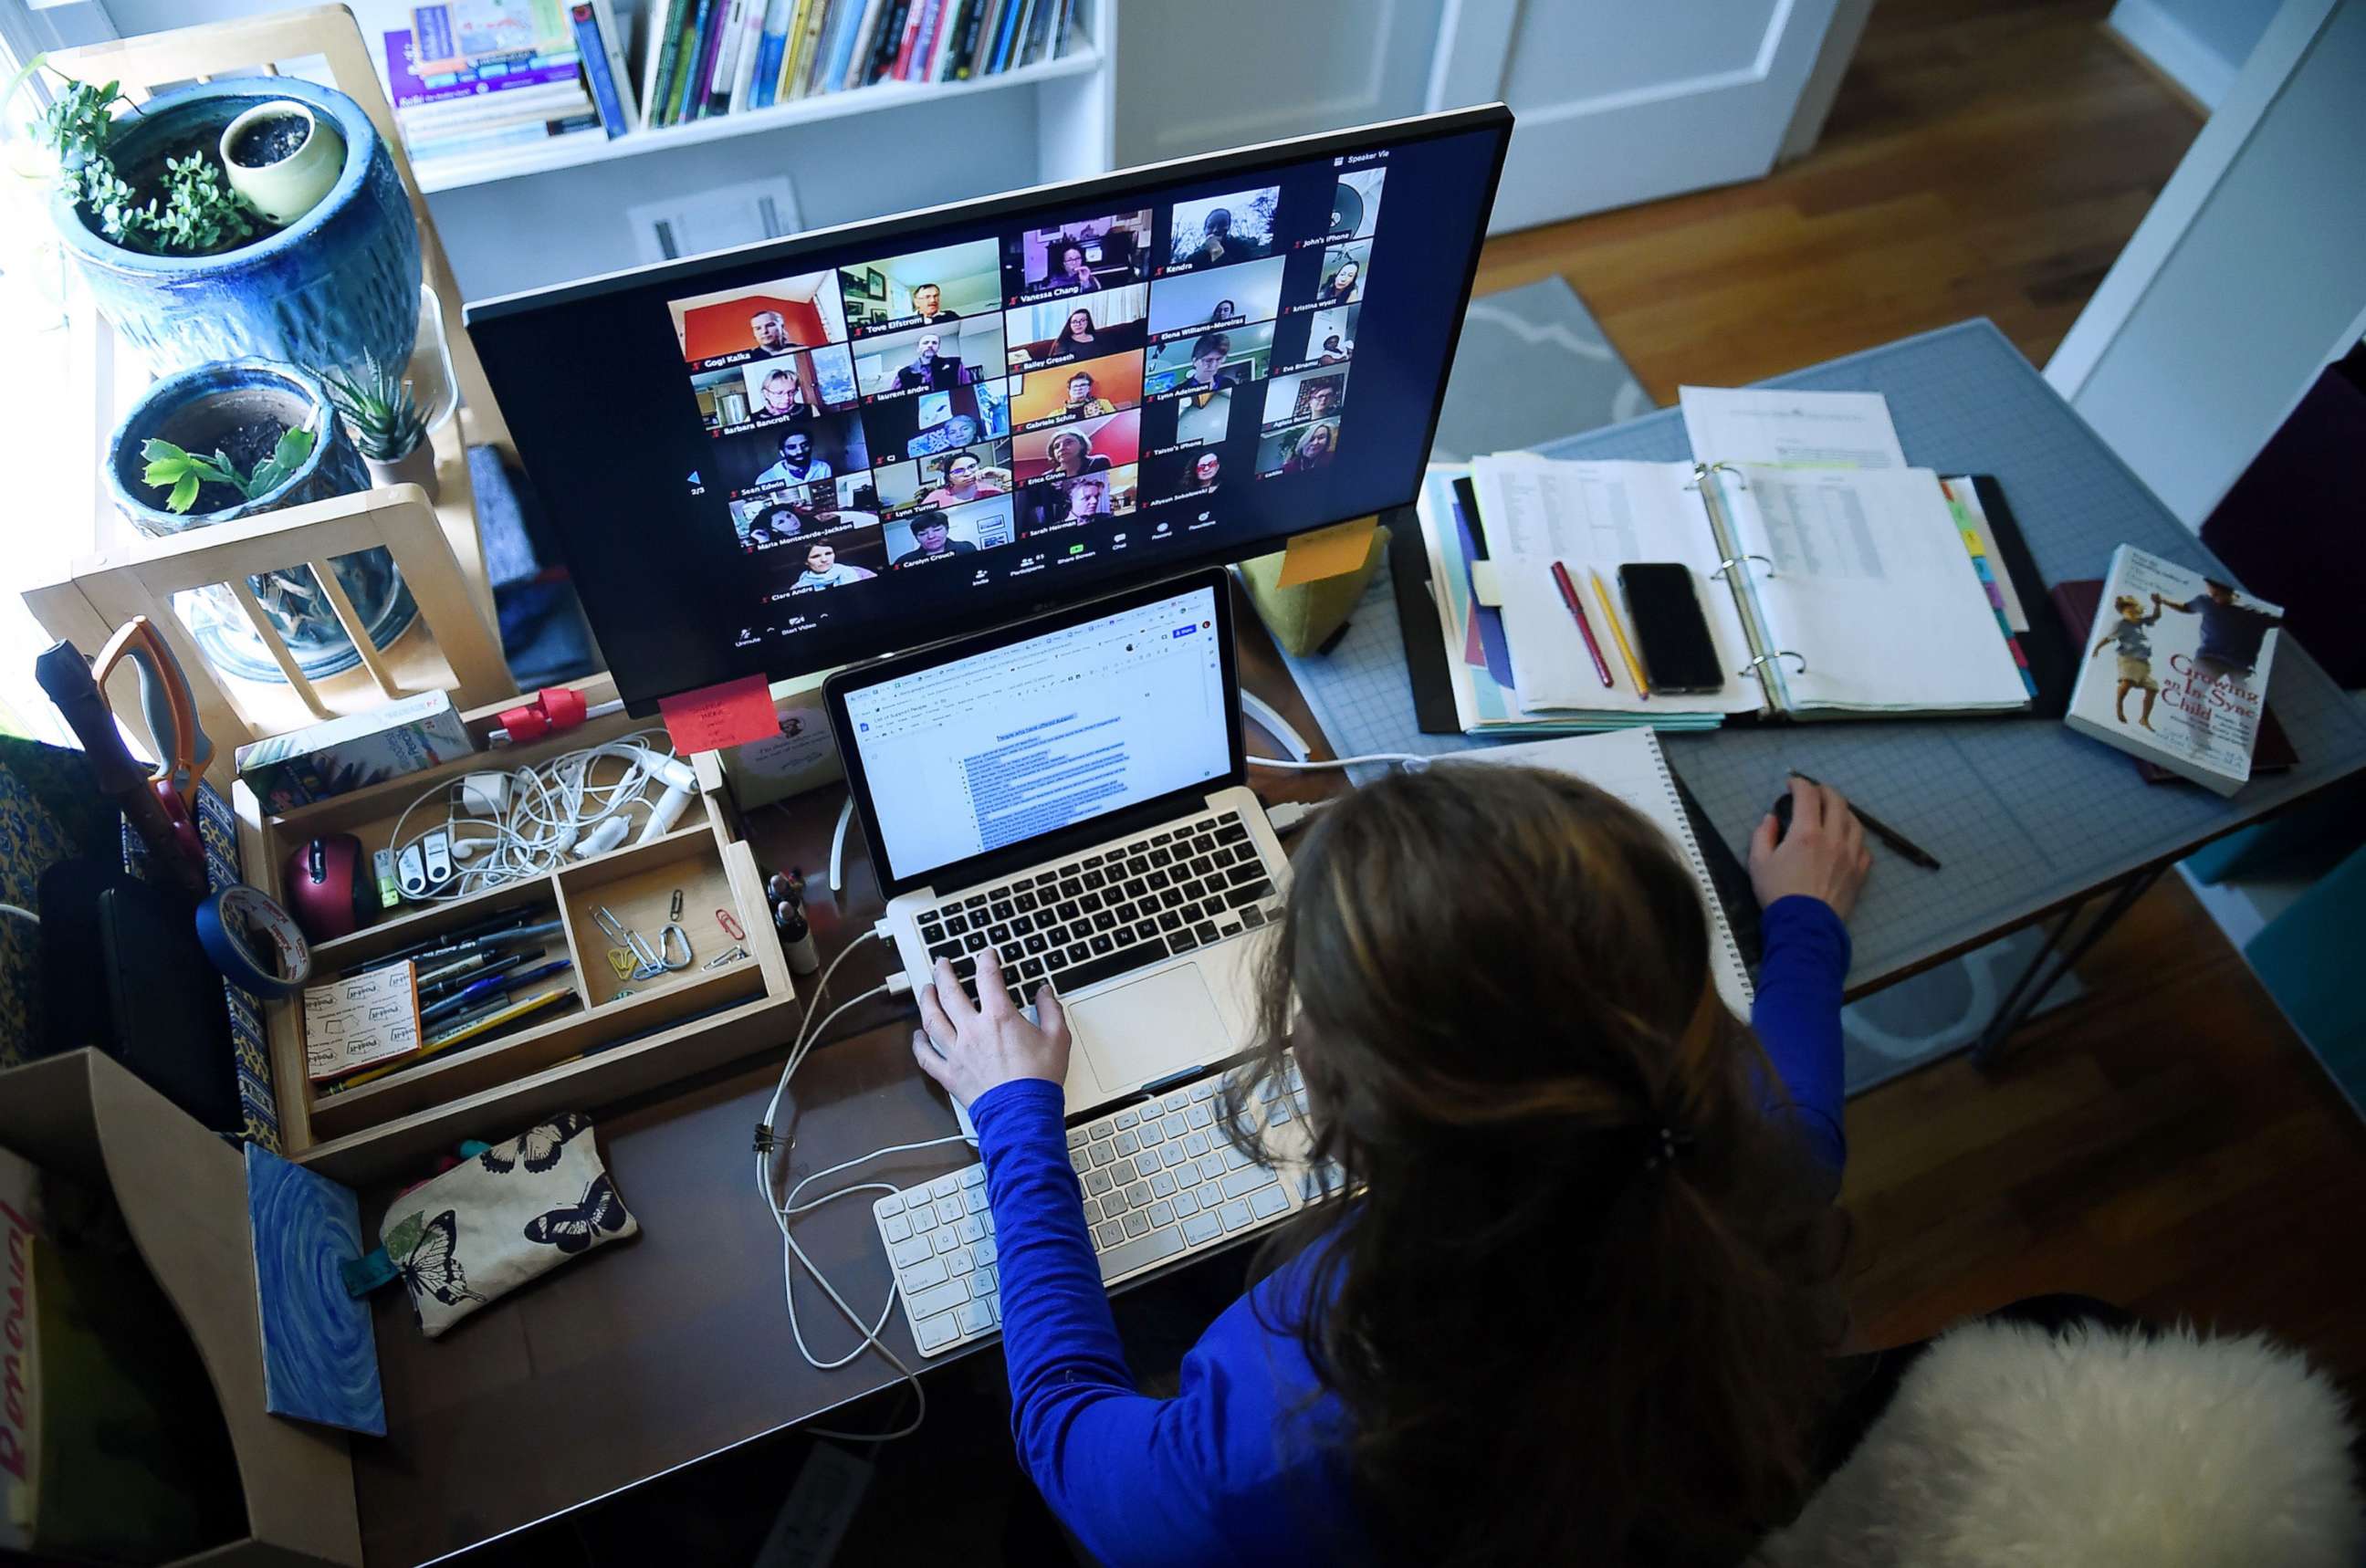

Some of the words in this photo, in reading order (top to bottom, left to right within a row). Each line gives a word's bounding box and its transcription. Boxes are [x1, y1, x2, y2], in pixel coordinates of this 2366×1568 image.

[1347, 153, 1377, 164] Speaker
[1303, 236, 1324, 248] John's
[1325, 233, 1350, 243] iPhone
[1166, 263, 1193, 274] Kendra
[1021, 291, 1052, 303] Vanessa
[1053, 286, 1079, 297] Chang
[865, 325, 886, 334] Tove
[888, 318, 923, 329] Elfstrom
[1161, 331, 1180, 340] Elena
[705, 357, 726, 368] Gogi
[1023, 359, 1045, 370] Bailey
[877, 390, 906, 401] laurent
[907, 384, 929, 395] andre
[1157, 391, 1174, 402] Lynn
[724, 423, 755, 435] Barbara
[757, 414, 790, 428] Bancroft
[1025, 419, 1054, 430] Gabriele
[1179, 440, 1202, 450] iPhone
[1028, 477, 1045, 486] Erica
[691, 486, 706, 497] 2/3
[741, 486, 760, 497] Sean
[761, 481, 785, 492] Edwin
[895, 508, 913, 518] Lynn
[914, 502, 937, 513] Turner
[1030, 528, 1048, 537] Sarah
[758, 541, 778, 551] Maria
[903, 557, 929, 569] Carolyn
[930, 550, 955, 562] Crouch
[771, 591, 790, 602] Clare
[792, 586, 813, 597] Andre
[735, 636, 761, 647] Unmute
[2164, 679, 2181, 690] an
[2171, 653, 2258, 705] Growing
[2162, 688, 2212, 721] Child
[1052, 955, 1059, 963] C
[350, 1039, 377, 1053] Post-it
[968, 1226, 976, 1234] W
[958, 1259, 965, 1267] A
